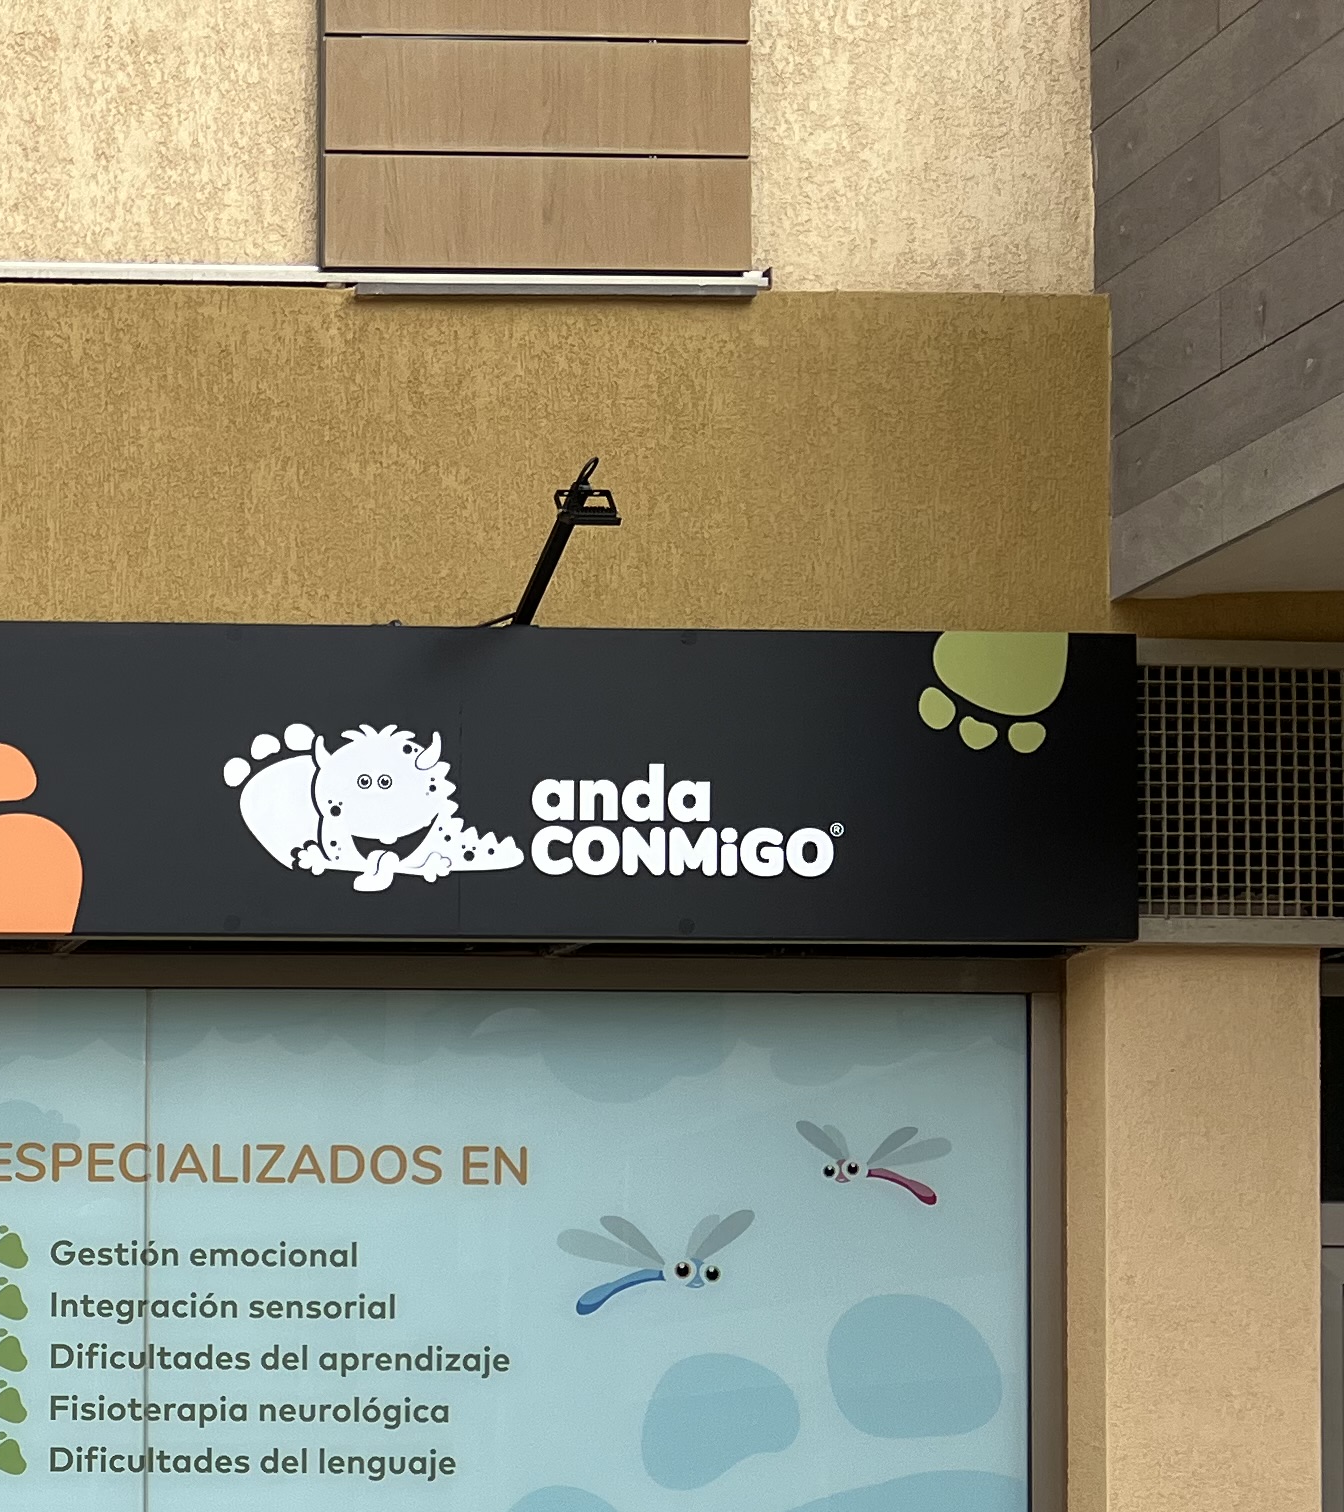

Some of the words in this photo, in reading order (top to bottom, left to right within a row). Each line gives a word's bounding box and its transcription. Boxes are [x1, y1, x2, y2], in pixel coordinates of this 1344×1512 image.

[531, 763, 711, 822] anda
[461, 1145, 529, 1186] EN
[49, 1240, 180, 1267] Gestión
[189, 1242, 358, 1268] emocional
[50, 1292, 238, 1325] Integración
[248, 1294, 396, 1320] sensorial
[49, 1343, 250, 1371] Dificultades
[260, 1345, 309, 1371] del
[318, 1345, 511, 1379] aprendizaje
[49, 1395, 248, 1427] Fisioterapia
[258, 1396, 450, 1430] neurológica
[49, 1447, 250, 1475] Dificultades
[260, 1449, 308, 1475] del
[318, 1449, 457, 1481] lenguaje
